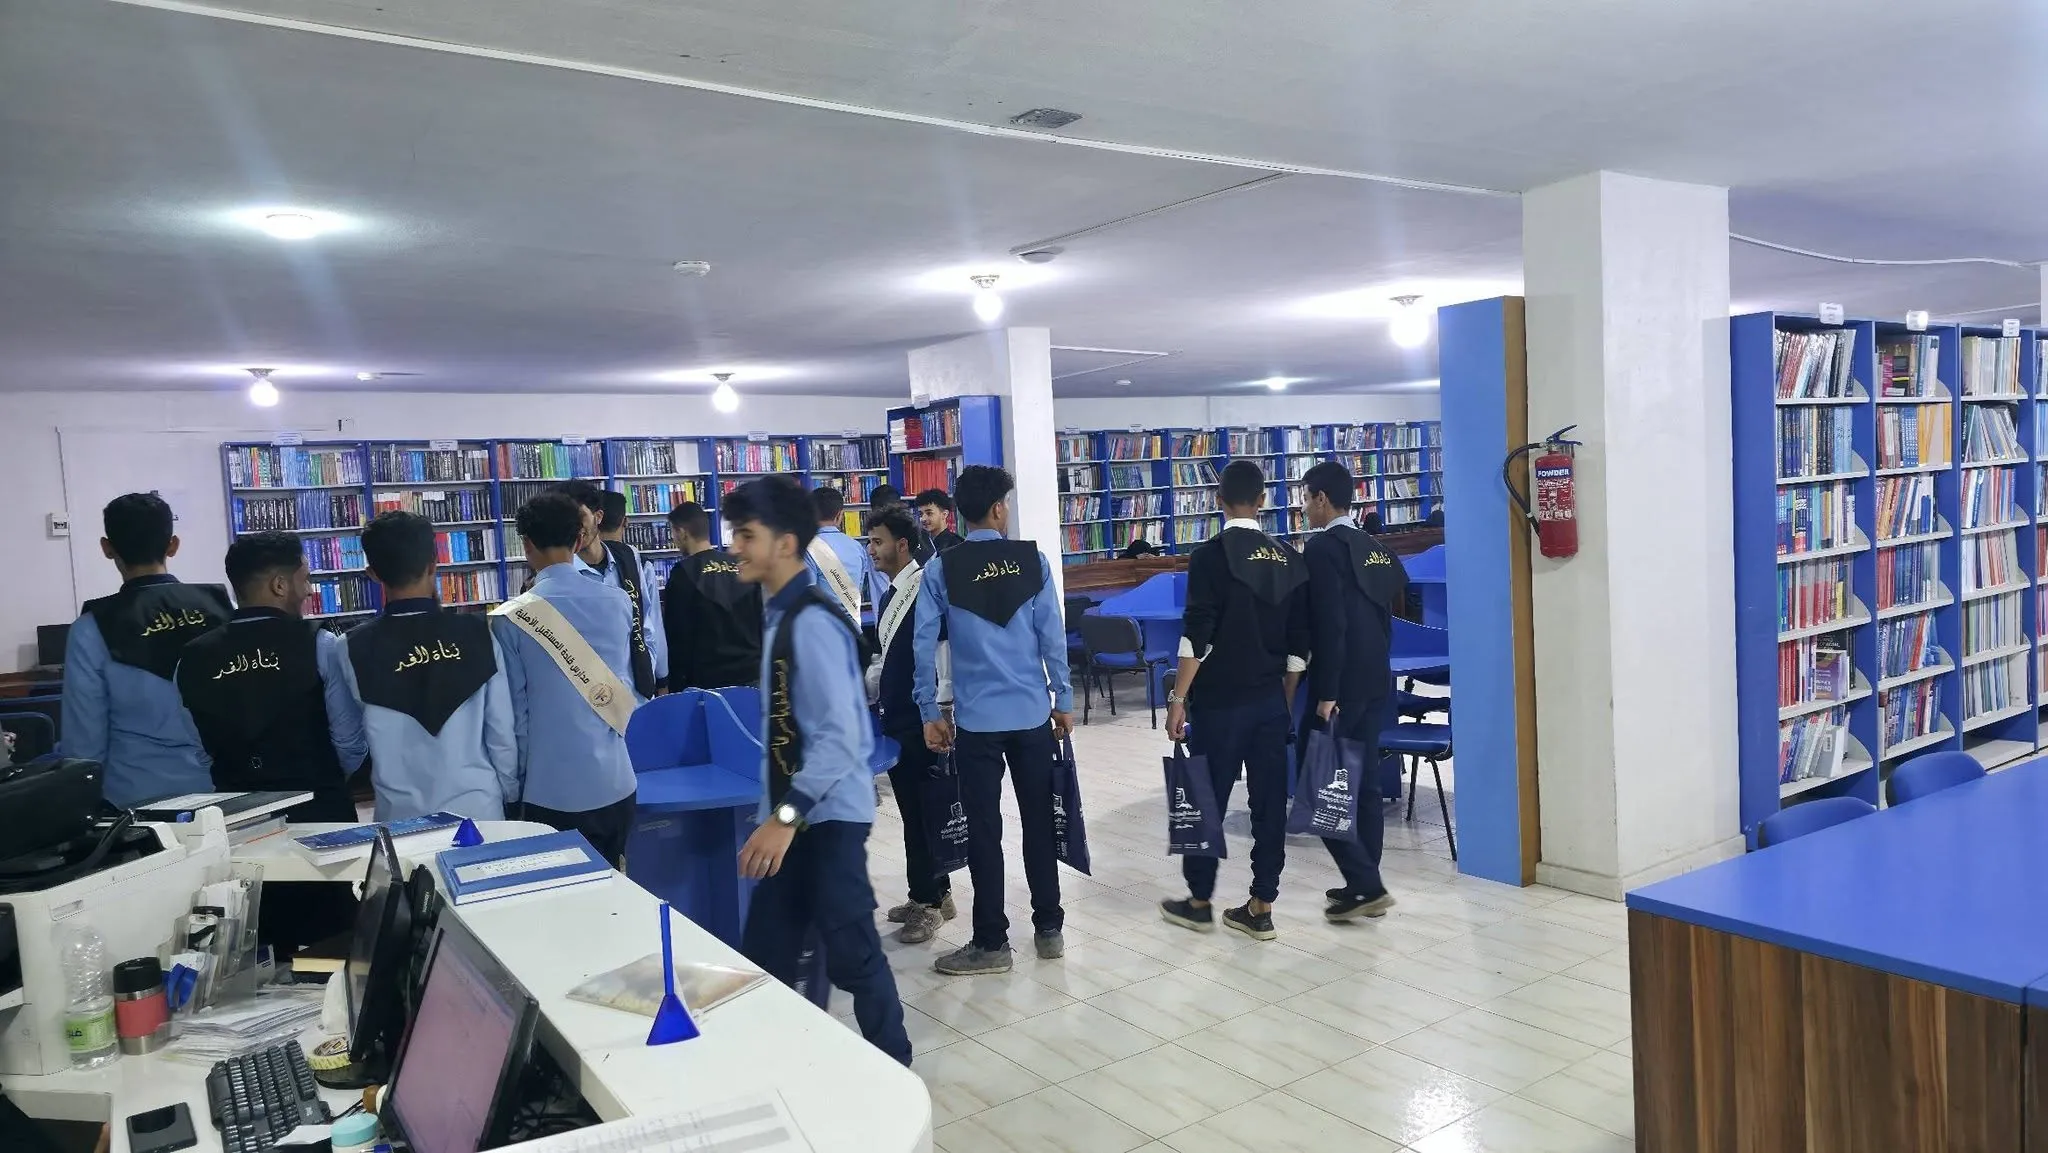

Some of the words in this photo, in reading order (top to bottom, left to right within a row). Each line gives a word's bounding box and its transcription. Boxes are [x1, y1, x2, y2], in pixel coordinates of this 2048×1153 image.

[1538, 468, 1570, 478] POWDER
[534, 623, 565, 652] المستقبل
[560, 648, 576, 665] قادة
[570, 661, 591, 685] مدارس
